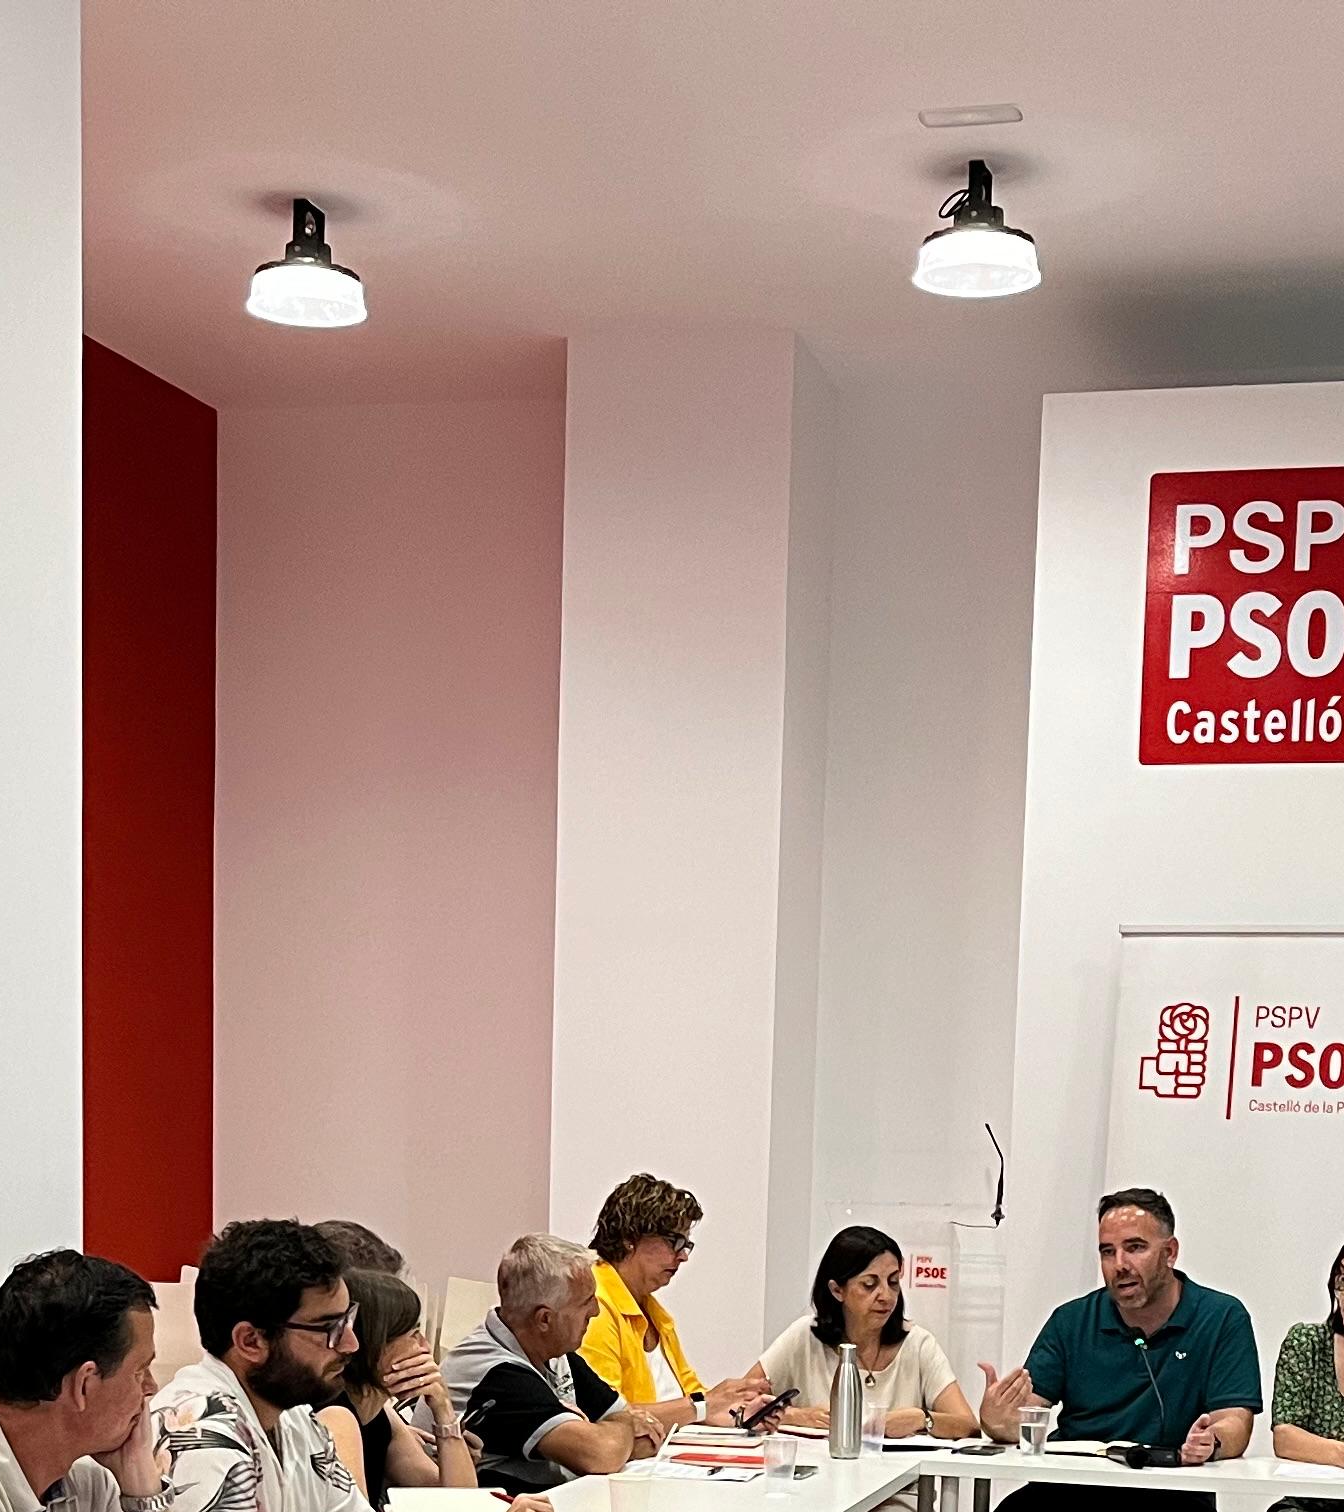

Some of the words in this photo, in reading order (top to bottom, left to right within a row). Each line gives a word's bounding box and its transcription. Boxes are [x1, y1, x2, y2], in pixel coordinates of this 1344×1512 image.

[1165, 695, 1343, 745] Castelló
[1255, 1005, 1321, 1029] PSPV
[1248, 1099, 1301, 1113] Castelló
[1304, 1100, 1320, 1113] de
[1322, 1101, 1334, 1114] la
[916, 1266, 947, 1280] PSOE
